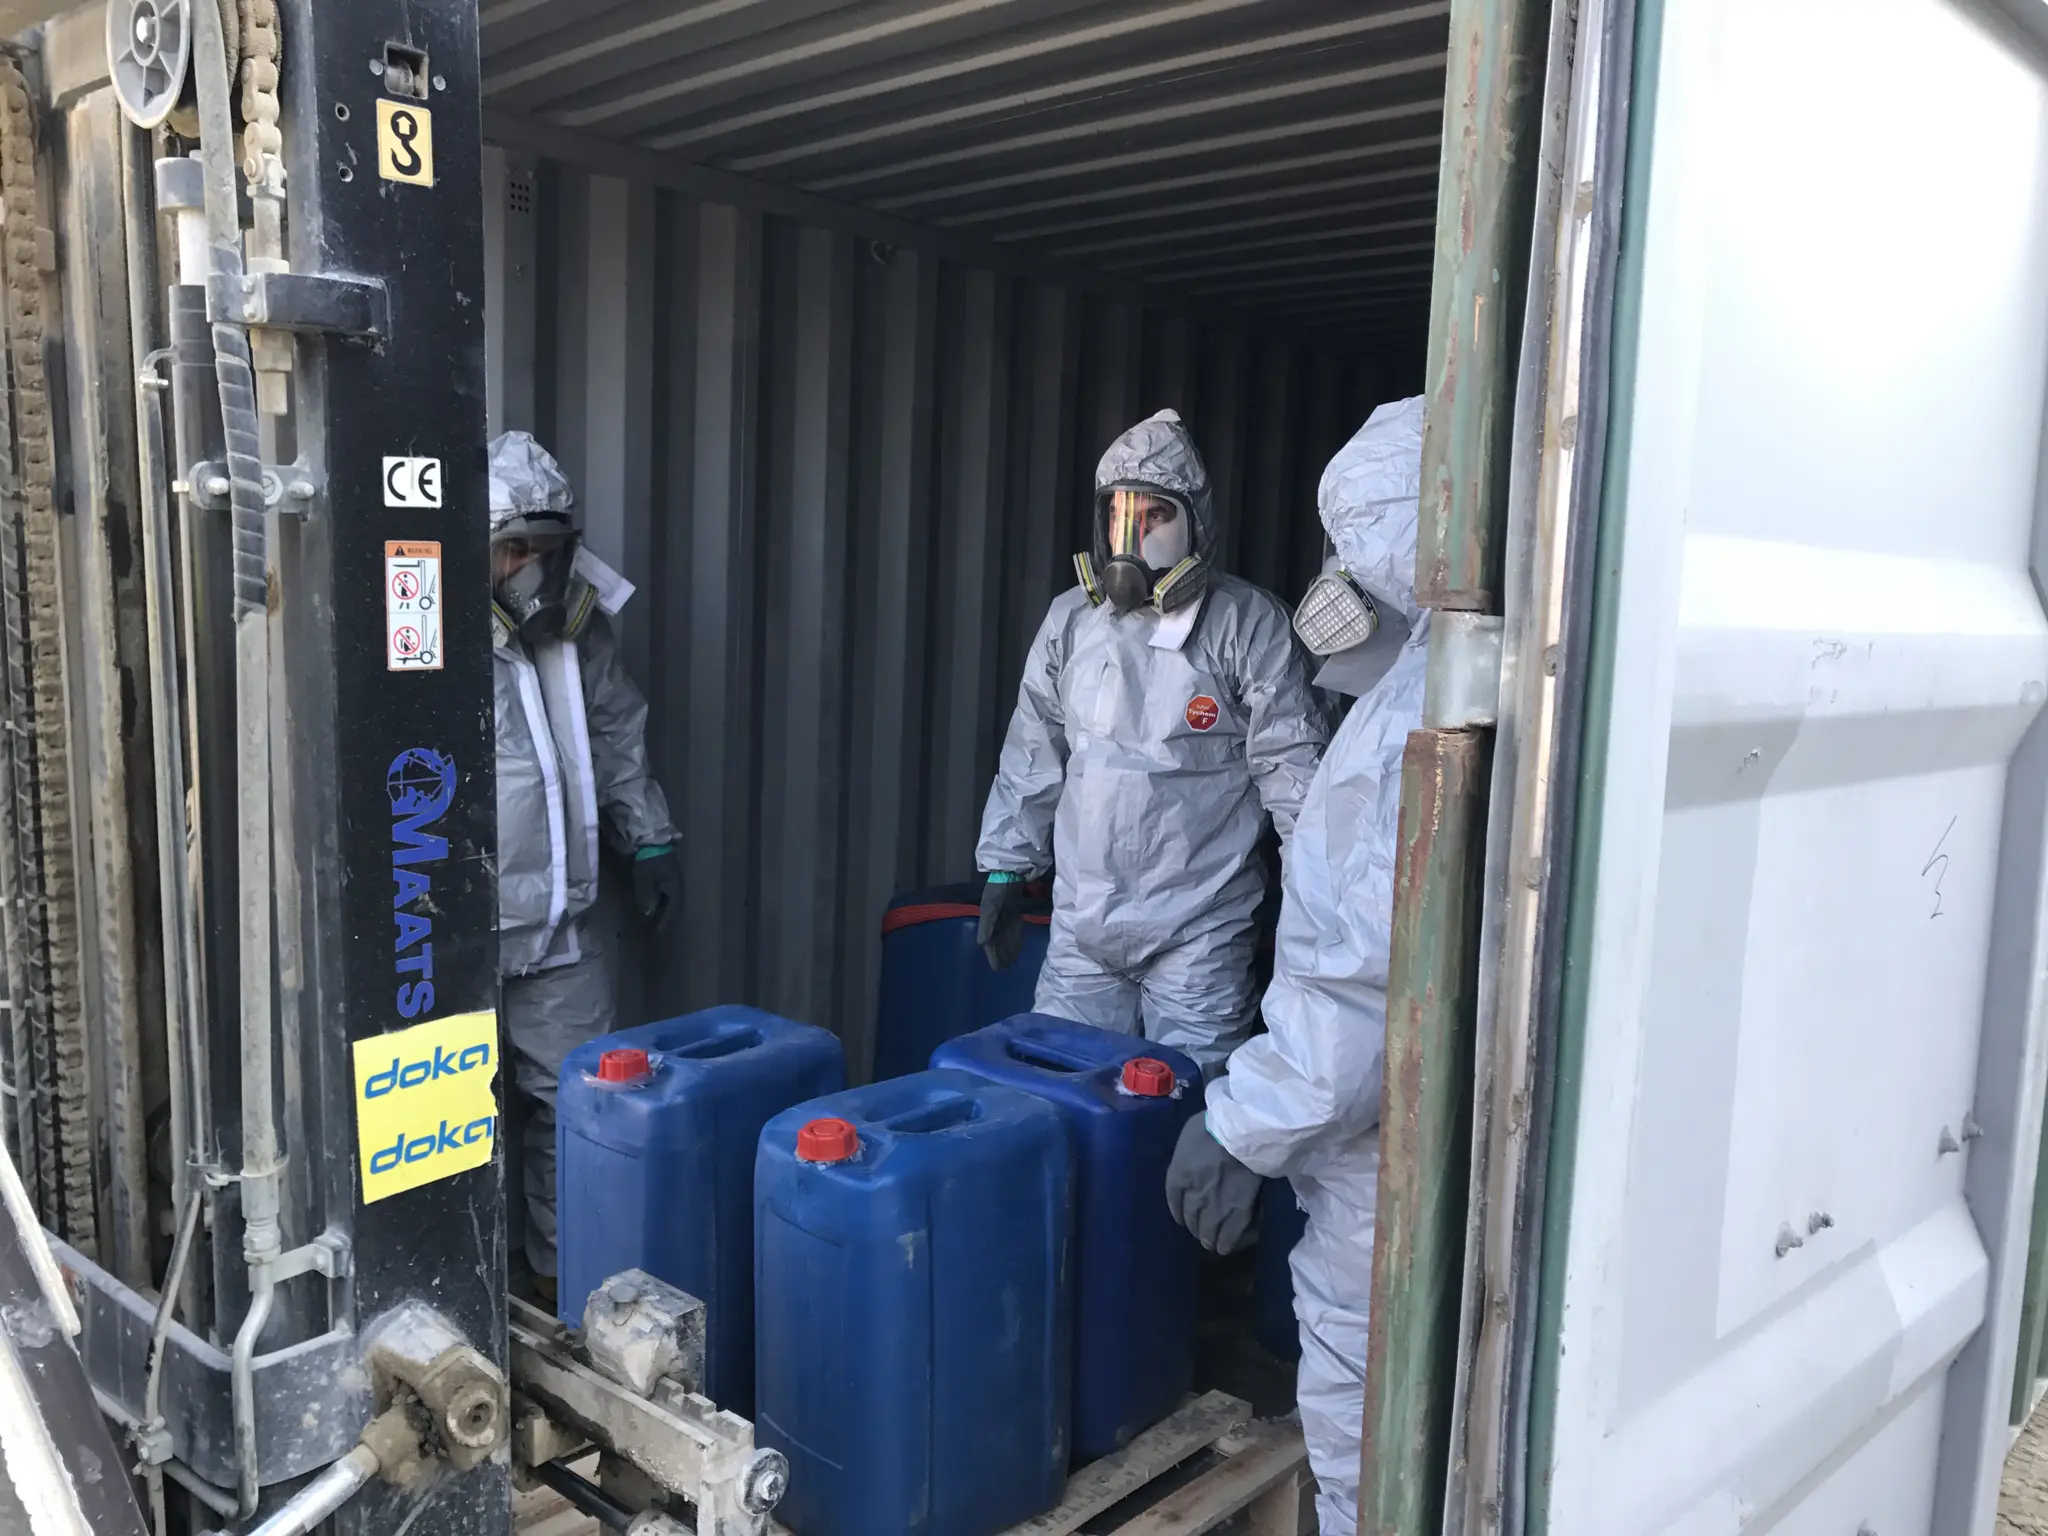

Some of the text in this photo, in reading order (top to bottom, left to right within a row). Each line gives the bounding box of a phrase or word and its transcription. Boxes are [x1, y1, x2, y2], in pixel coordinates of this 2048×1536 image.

[387, 461, 437, 502] CE
[1189, 708, 1216, 718] Tychem
[1202, 717, 1209, 725] F
[390, 790, 455, 1018] MAATS
[365, 1043, 490, 1100] doka
[370, 1116, 493, 1175] doka
